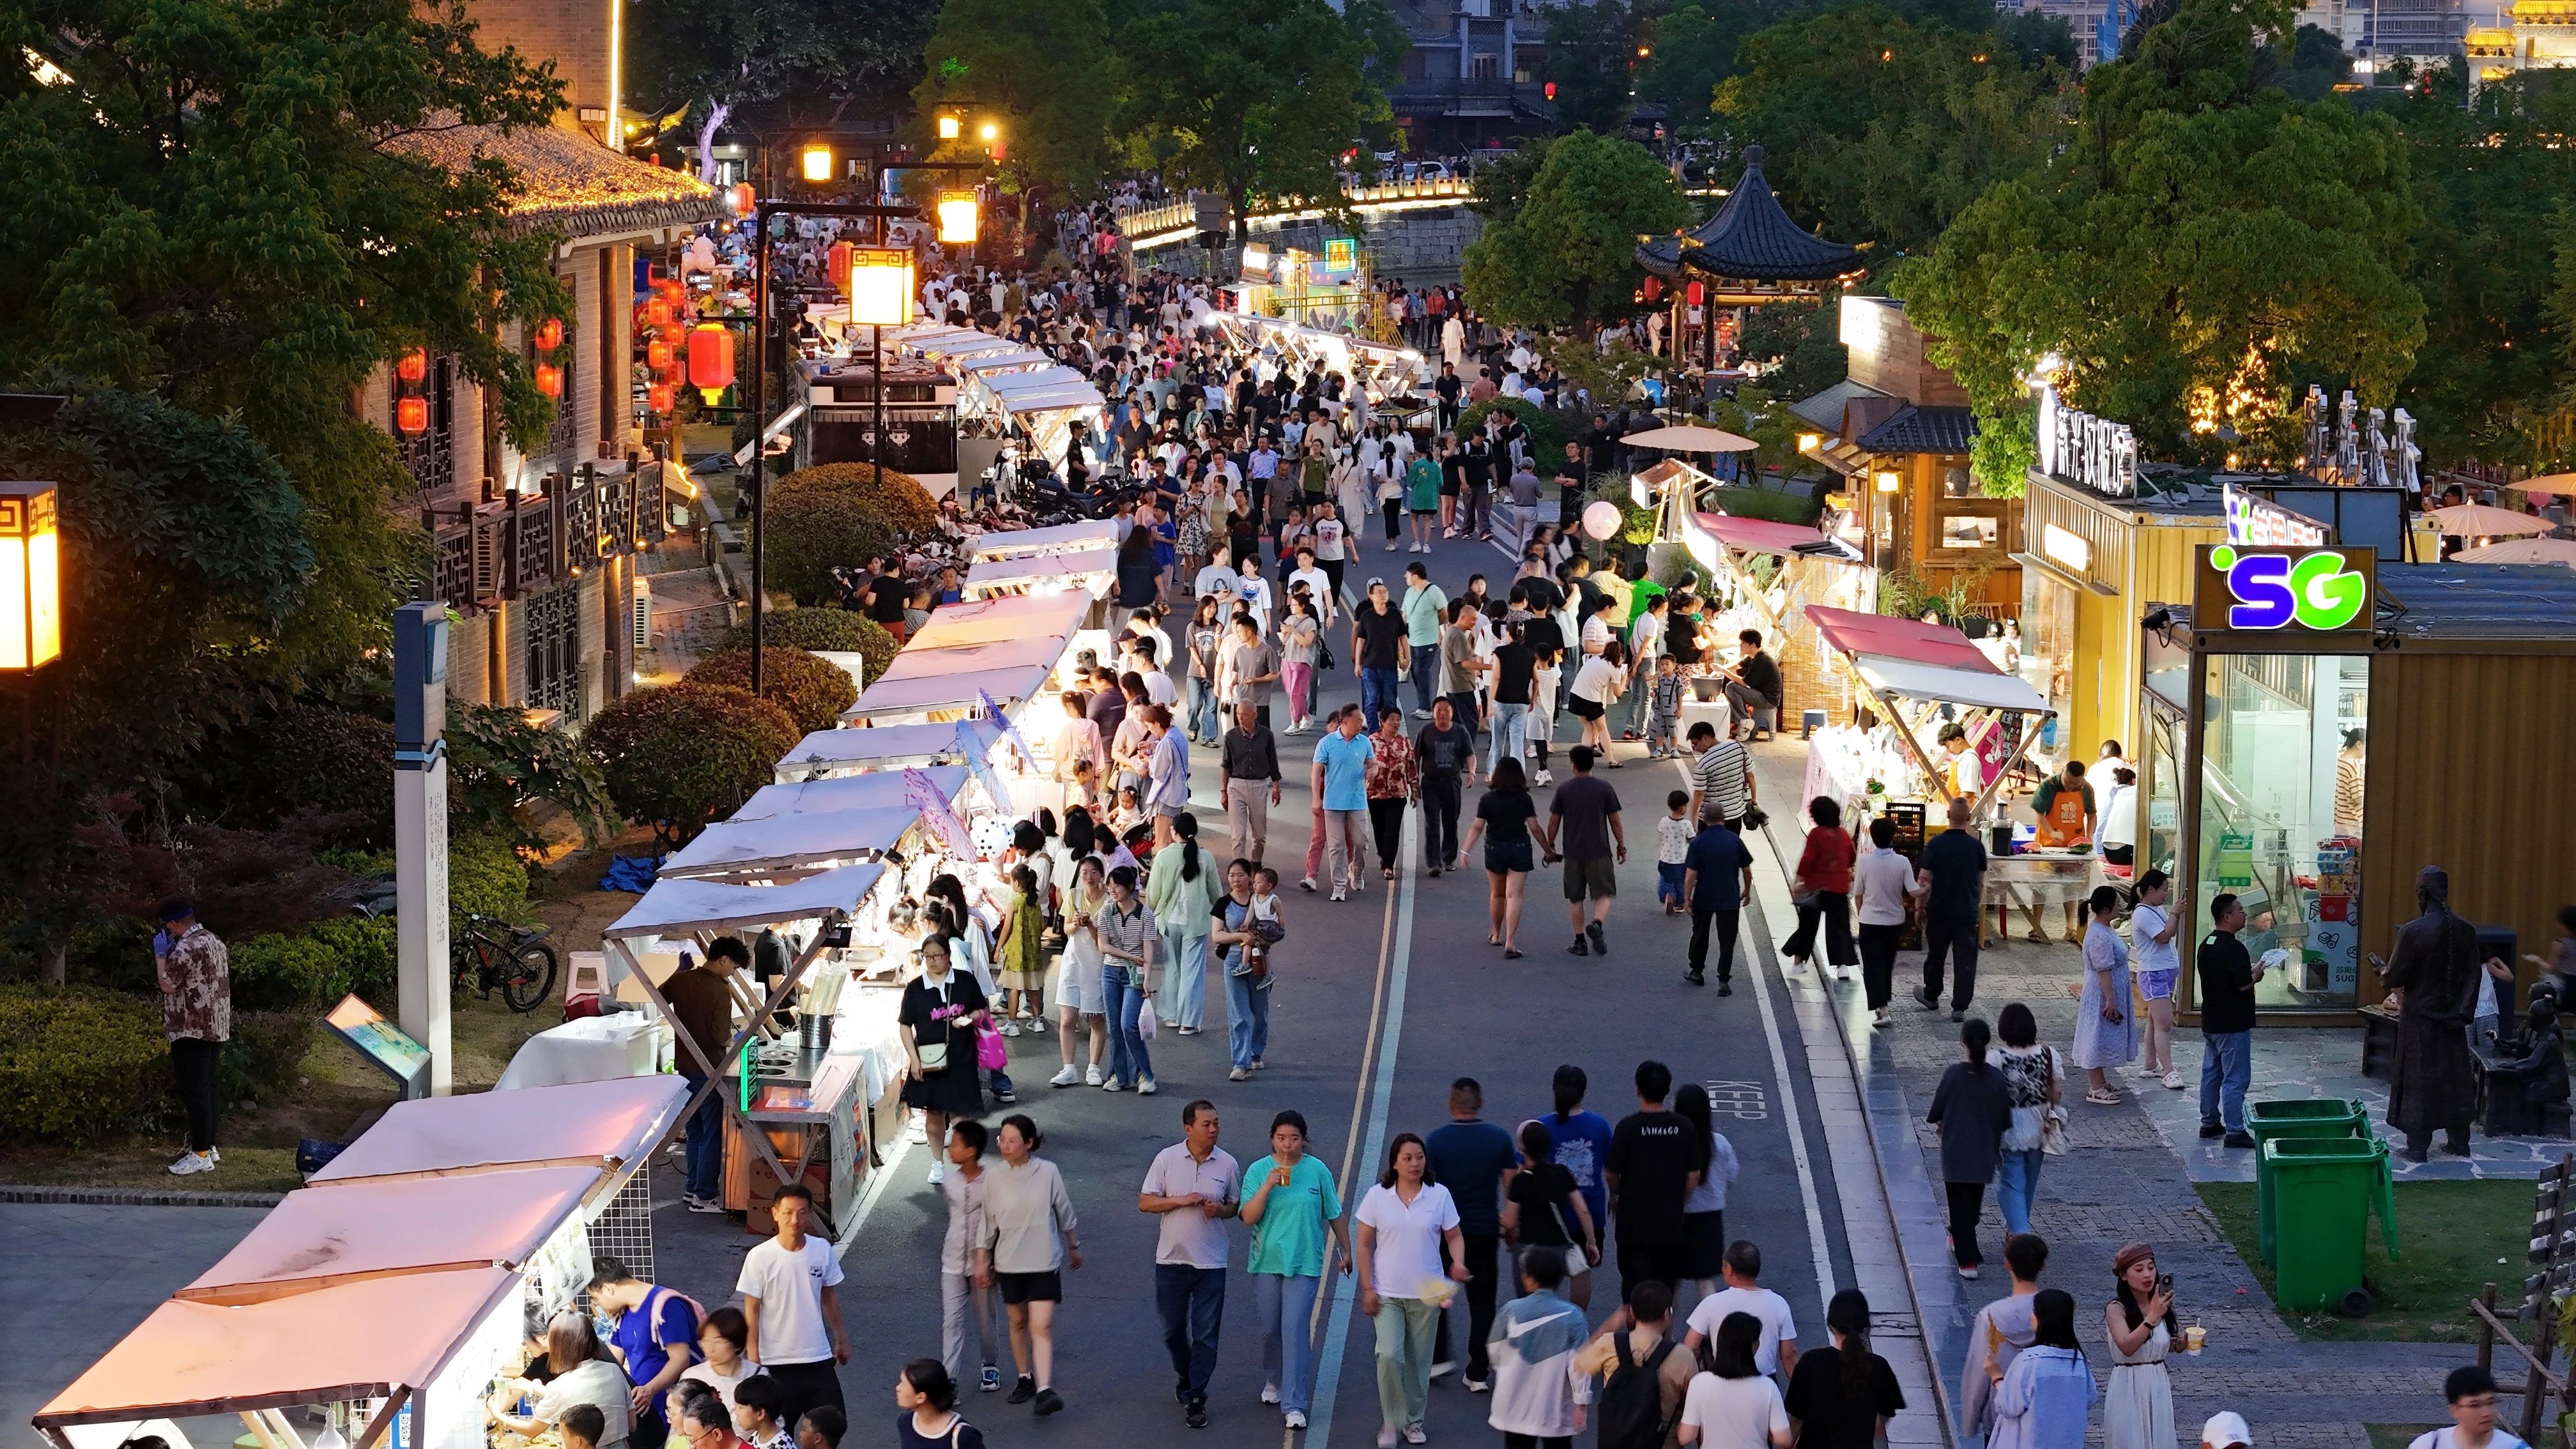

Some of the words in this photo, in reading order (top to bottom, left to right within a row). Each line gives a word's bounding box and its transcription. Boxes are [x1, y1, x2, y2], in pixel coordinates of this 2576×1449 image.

[2353, 60, 2373, 73] 110
[2227, 550, 2366, 630] SG
[1706, 1080, 1768, 1120] KEEP
